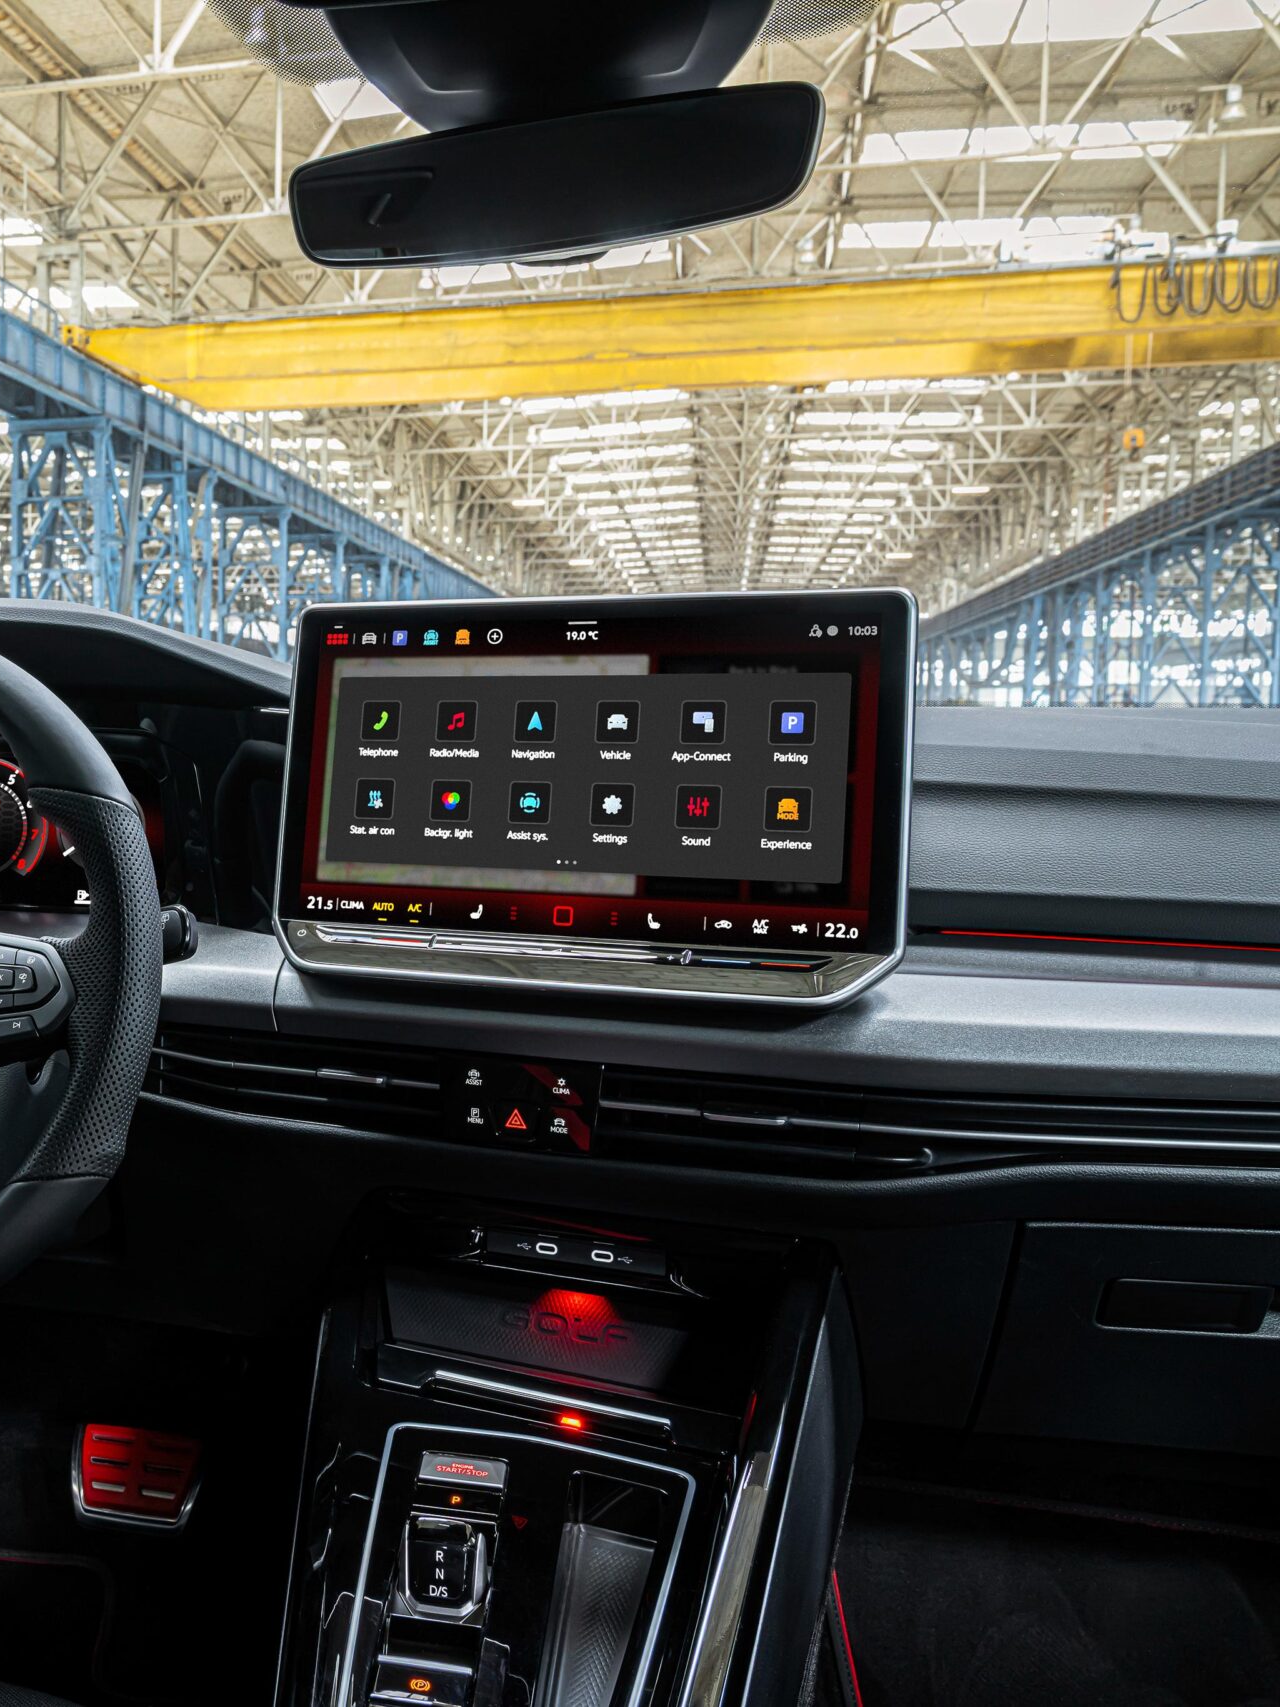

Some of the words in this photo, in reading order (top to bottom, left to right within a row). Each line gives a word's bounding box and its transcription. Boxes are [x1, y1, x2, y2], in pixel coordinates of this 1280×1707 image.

[566, 631, 588, 640] 19.0
[848, 625, 878, 636] 10:03
[359, 747, 399, 758] Telephone
[429, 748, 479, 759] Radio/Media
[511, 749, 555, 760] Navigation
[600, 751, 631, 761] Vehicle
[671, 751, 731, 762] App-Connect
[773, 752, 808, 764] Parking
[7, 774, 16, 785] 5
[30, 828, 39, 840] 7
[349, 825, 367, 834] Stat.
[368, 825, 377, 835] air
[378, 828, 395, 836] con
[424, 827, 452, 838] Backgr.
[454, 828, 473, 839] light
[507, 830, 530, 840] Assist
[532, 833, 548, 841] sys.
[592, 832, 628, 845] Settings
[681, 836, 711, 846] Sound
[760, 838, 812, 850] Experience
[306, 896, 333, 910] 21.5
[340, 900, 364, 910] CLIMA
[372, 903, 394, 912] AUTO
[407, 904, 422, 913] A/C
[752, 919, 769, 929] A/C
[825, 922, 859, 939] 22.0
[465, 1078, 482, 1086] ASSIST
[553, 1087, 570, 1095] CLIMA
[467, 1117, 484, 1125] MENU
[550, 1126, 568, 1134] MODE
[436, 1466, 489, 1477] START/STOP
[452, 1496, 461, 1504] P
[435, 1551, 444, 1562] R
[435, 1569, 445, 1580] N
[429, 1585, 448, 1598] D/S
